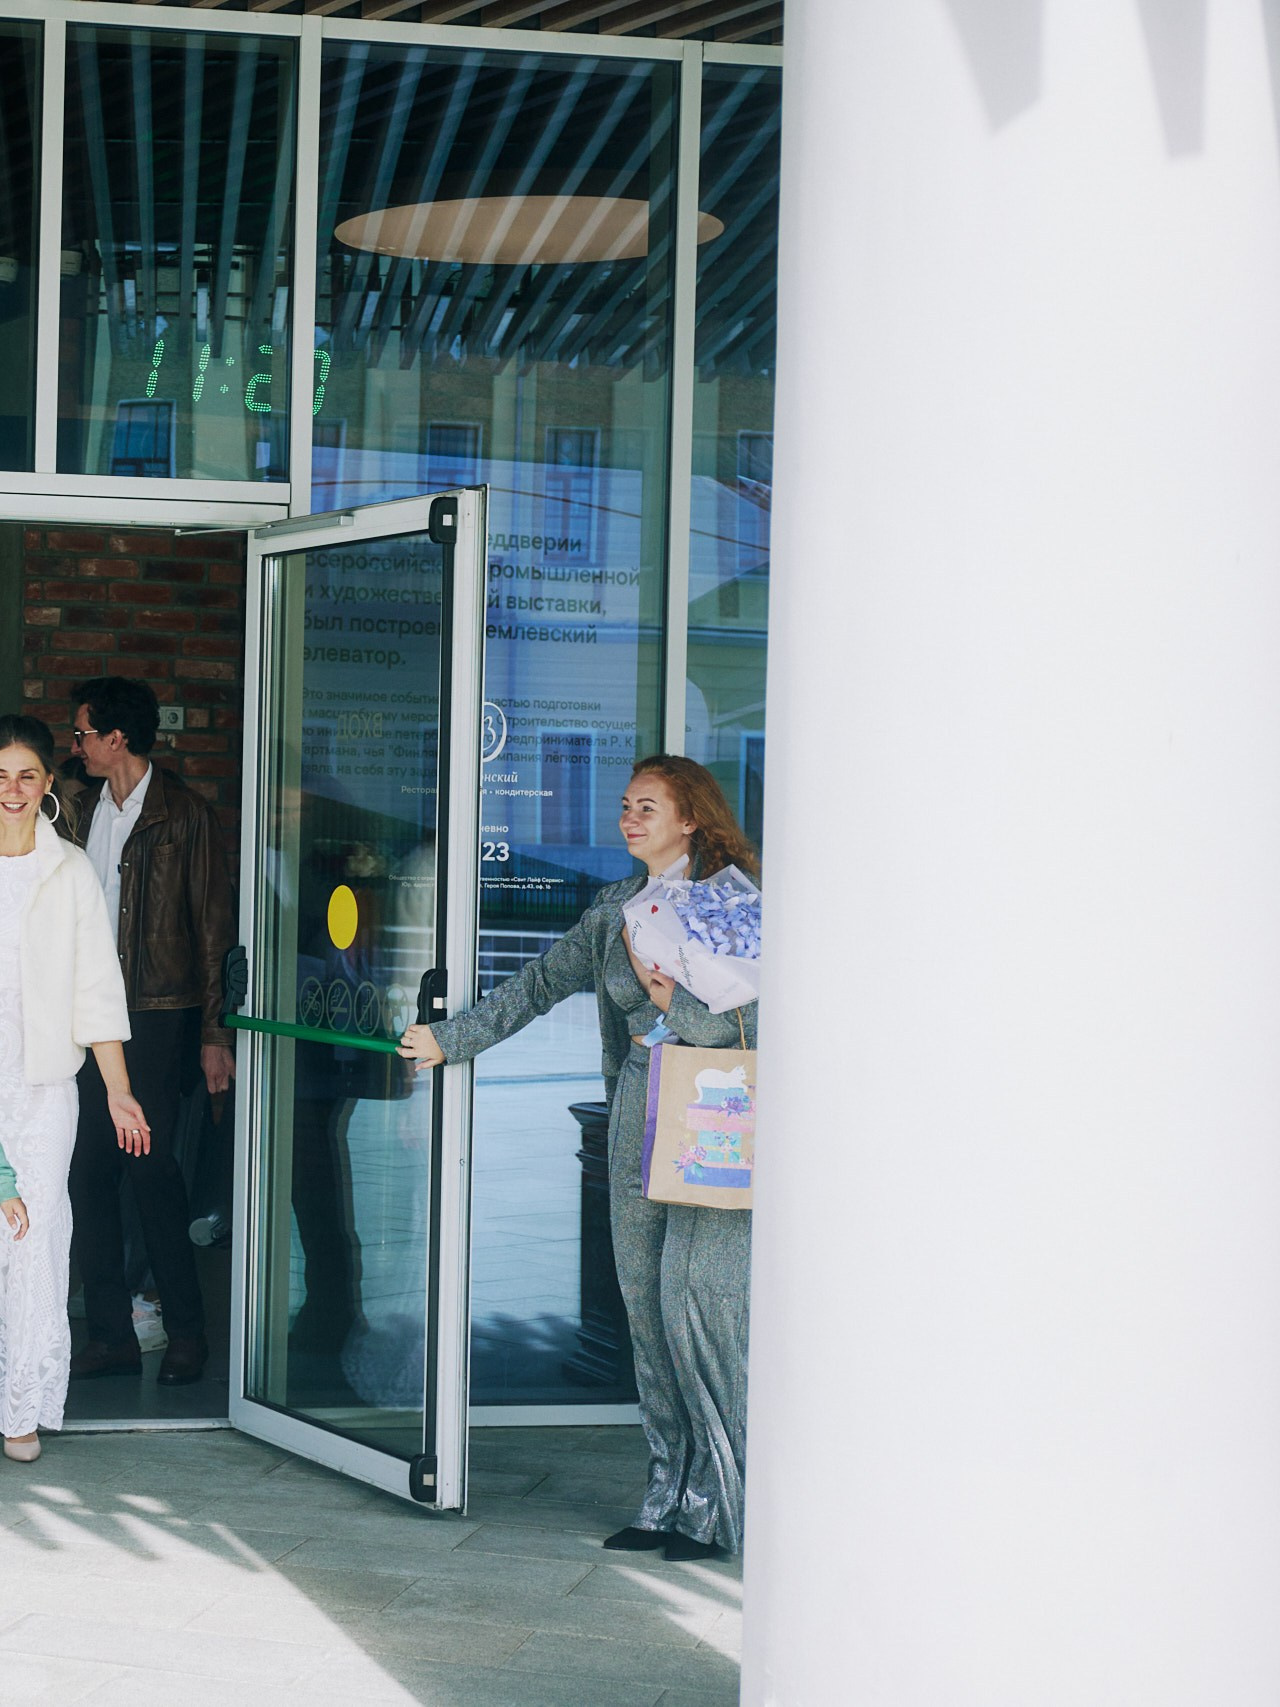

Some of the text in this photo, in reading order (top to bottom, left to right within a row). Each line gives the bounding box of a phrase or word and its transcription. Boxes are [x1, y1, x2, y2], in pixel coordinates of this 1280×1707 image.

[487, 532, 582, 555] ддверии
[305, 552, 640, 586] Всероссийск ромышленной
[506, 595, 607, 616] выставки,
[349, 615, 440, 638] построе
[486, 623, 597, 644] емлевский
[304, 645, 406, 669] элеватор.
[326, 691, 387, 702] значимое
[533, 700, 601, 711] подготовки
[591, 720, 637, 732] осущес
[302, 743, 361, 758] артмана,
[545, 751, 591, 763] лёгкого
[483, 771, 518, 783] нский
[401, 785, 438, 796] Рестора
[495, 788, 553, 799] кондитерская
[482, 841, 510, 862] 23
